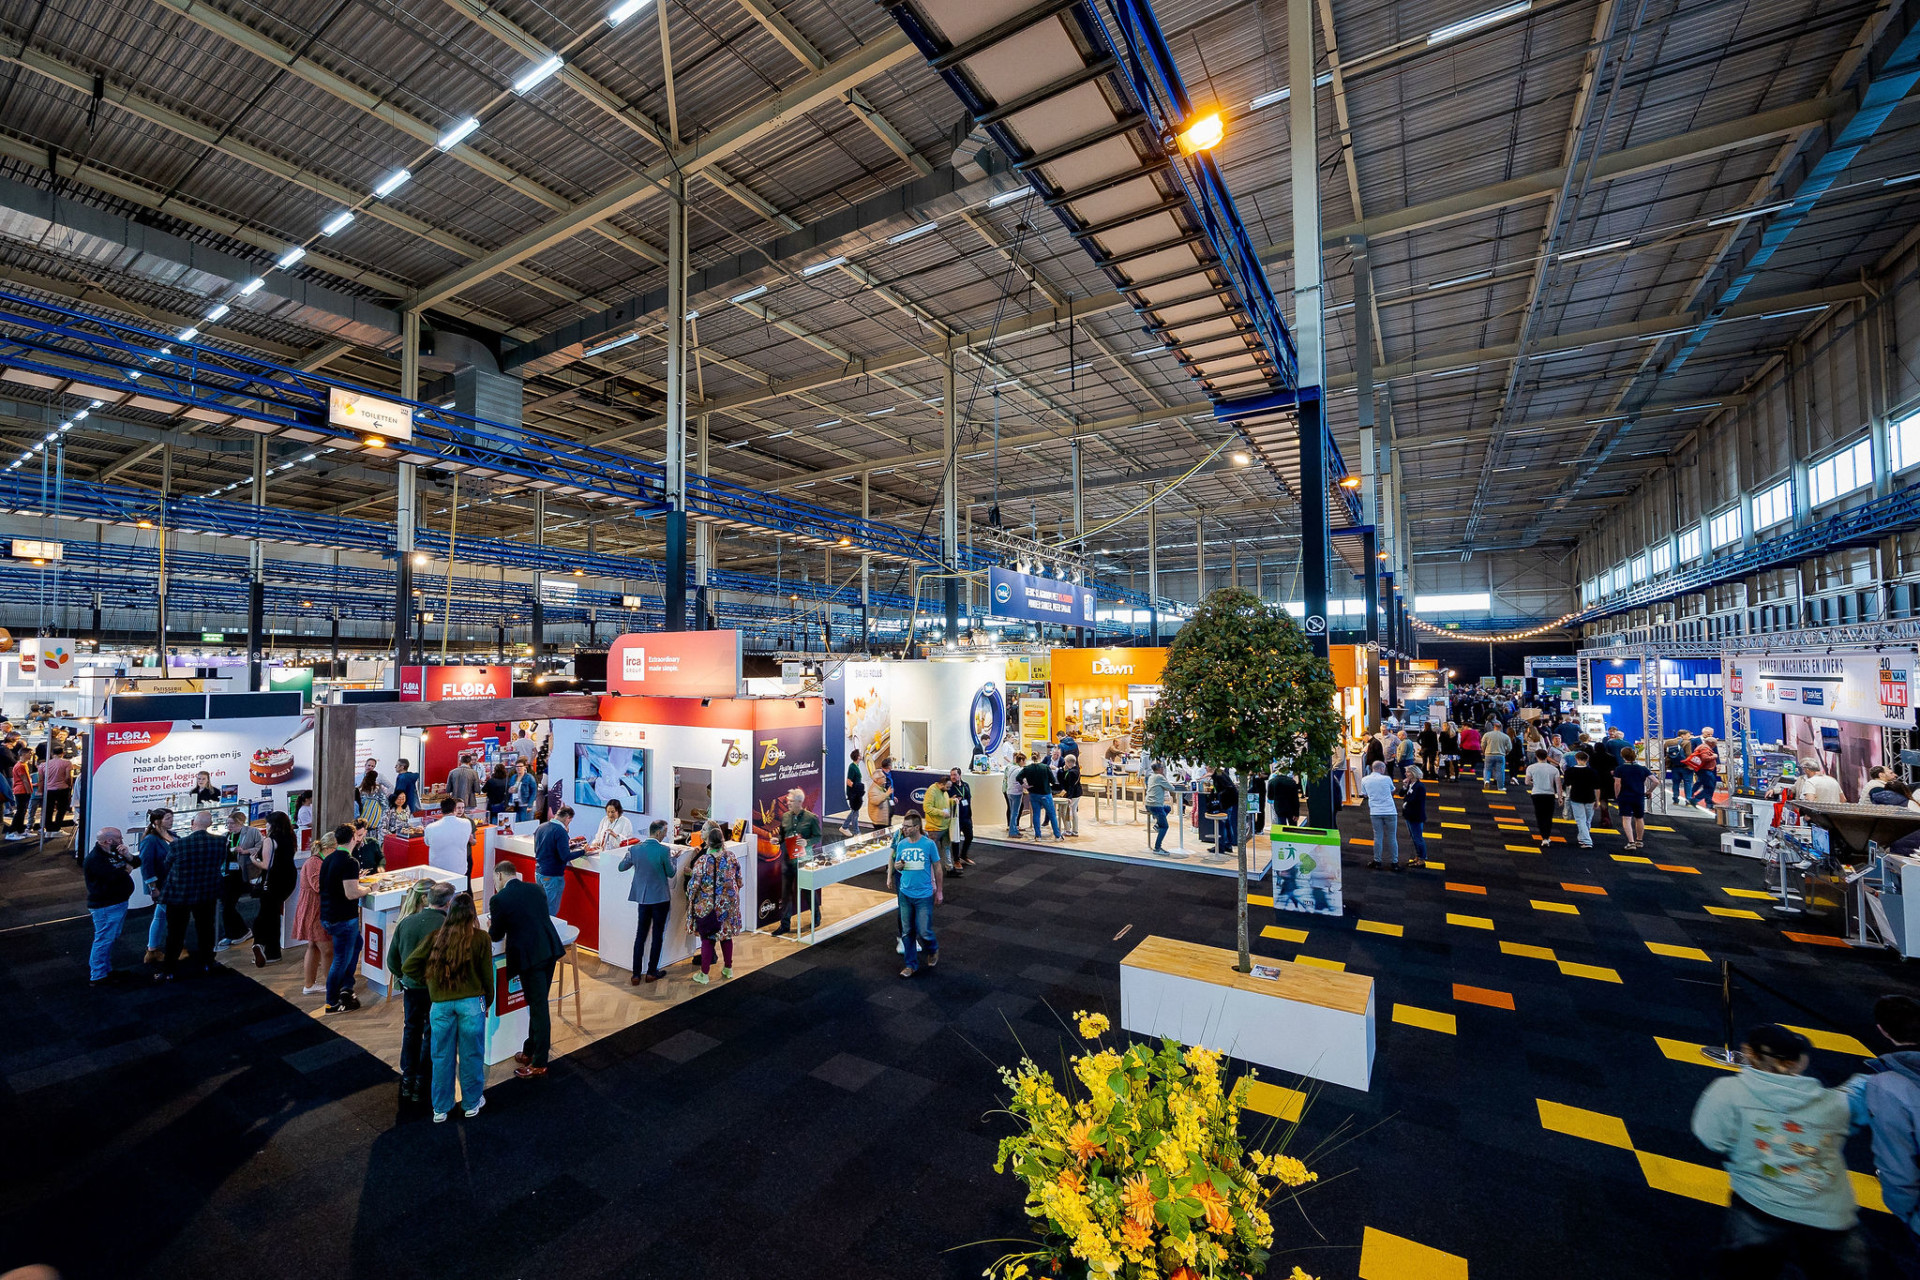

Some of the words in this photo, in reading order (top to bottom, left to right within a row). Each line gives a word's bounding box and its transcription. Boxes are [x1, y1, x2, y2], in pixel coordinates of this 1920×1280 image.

[361, 411, 398, 424] TOILETTEN
[626, 656, 641, 666] irca
[648, 656, 680, 664] Extraordinary
[1759, 659, 1809, 673] BAKKERIJMACHINES
[1812, 659, 1820, 673] EN
[1822, 658, 1843, 673] OVENS
[1880, 657, 1890, 670] 40
[1092, 659, 1133, 674] Dawn
[1892, 672, 1906, 680] VAN
[403, 682, 419, 690] FLORA
[442, 683, 497, 696] FLORA
[1671, 689, 1724, 697] BENELUX
[1880, 684, 1906, 704] VLIET
[1885, 705, 1905, 720] JAAR
[107, 731, 151, 740] FLORA
[168, 754, 194, 762] boter,
[232, 750, 242, 759] ijs
[133, 765, 155, 773] maar
[158, 762, 174, 771] dan
[176, 761, 202, 770] beter!
[132, 774, 173, 784] slimmer,
[132, 784, 147, 793] net
[150, 783, 162, 791] zo
[163, 780, 194, 789] lekker!
